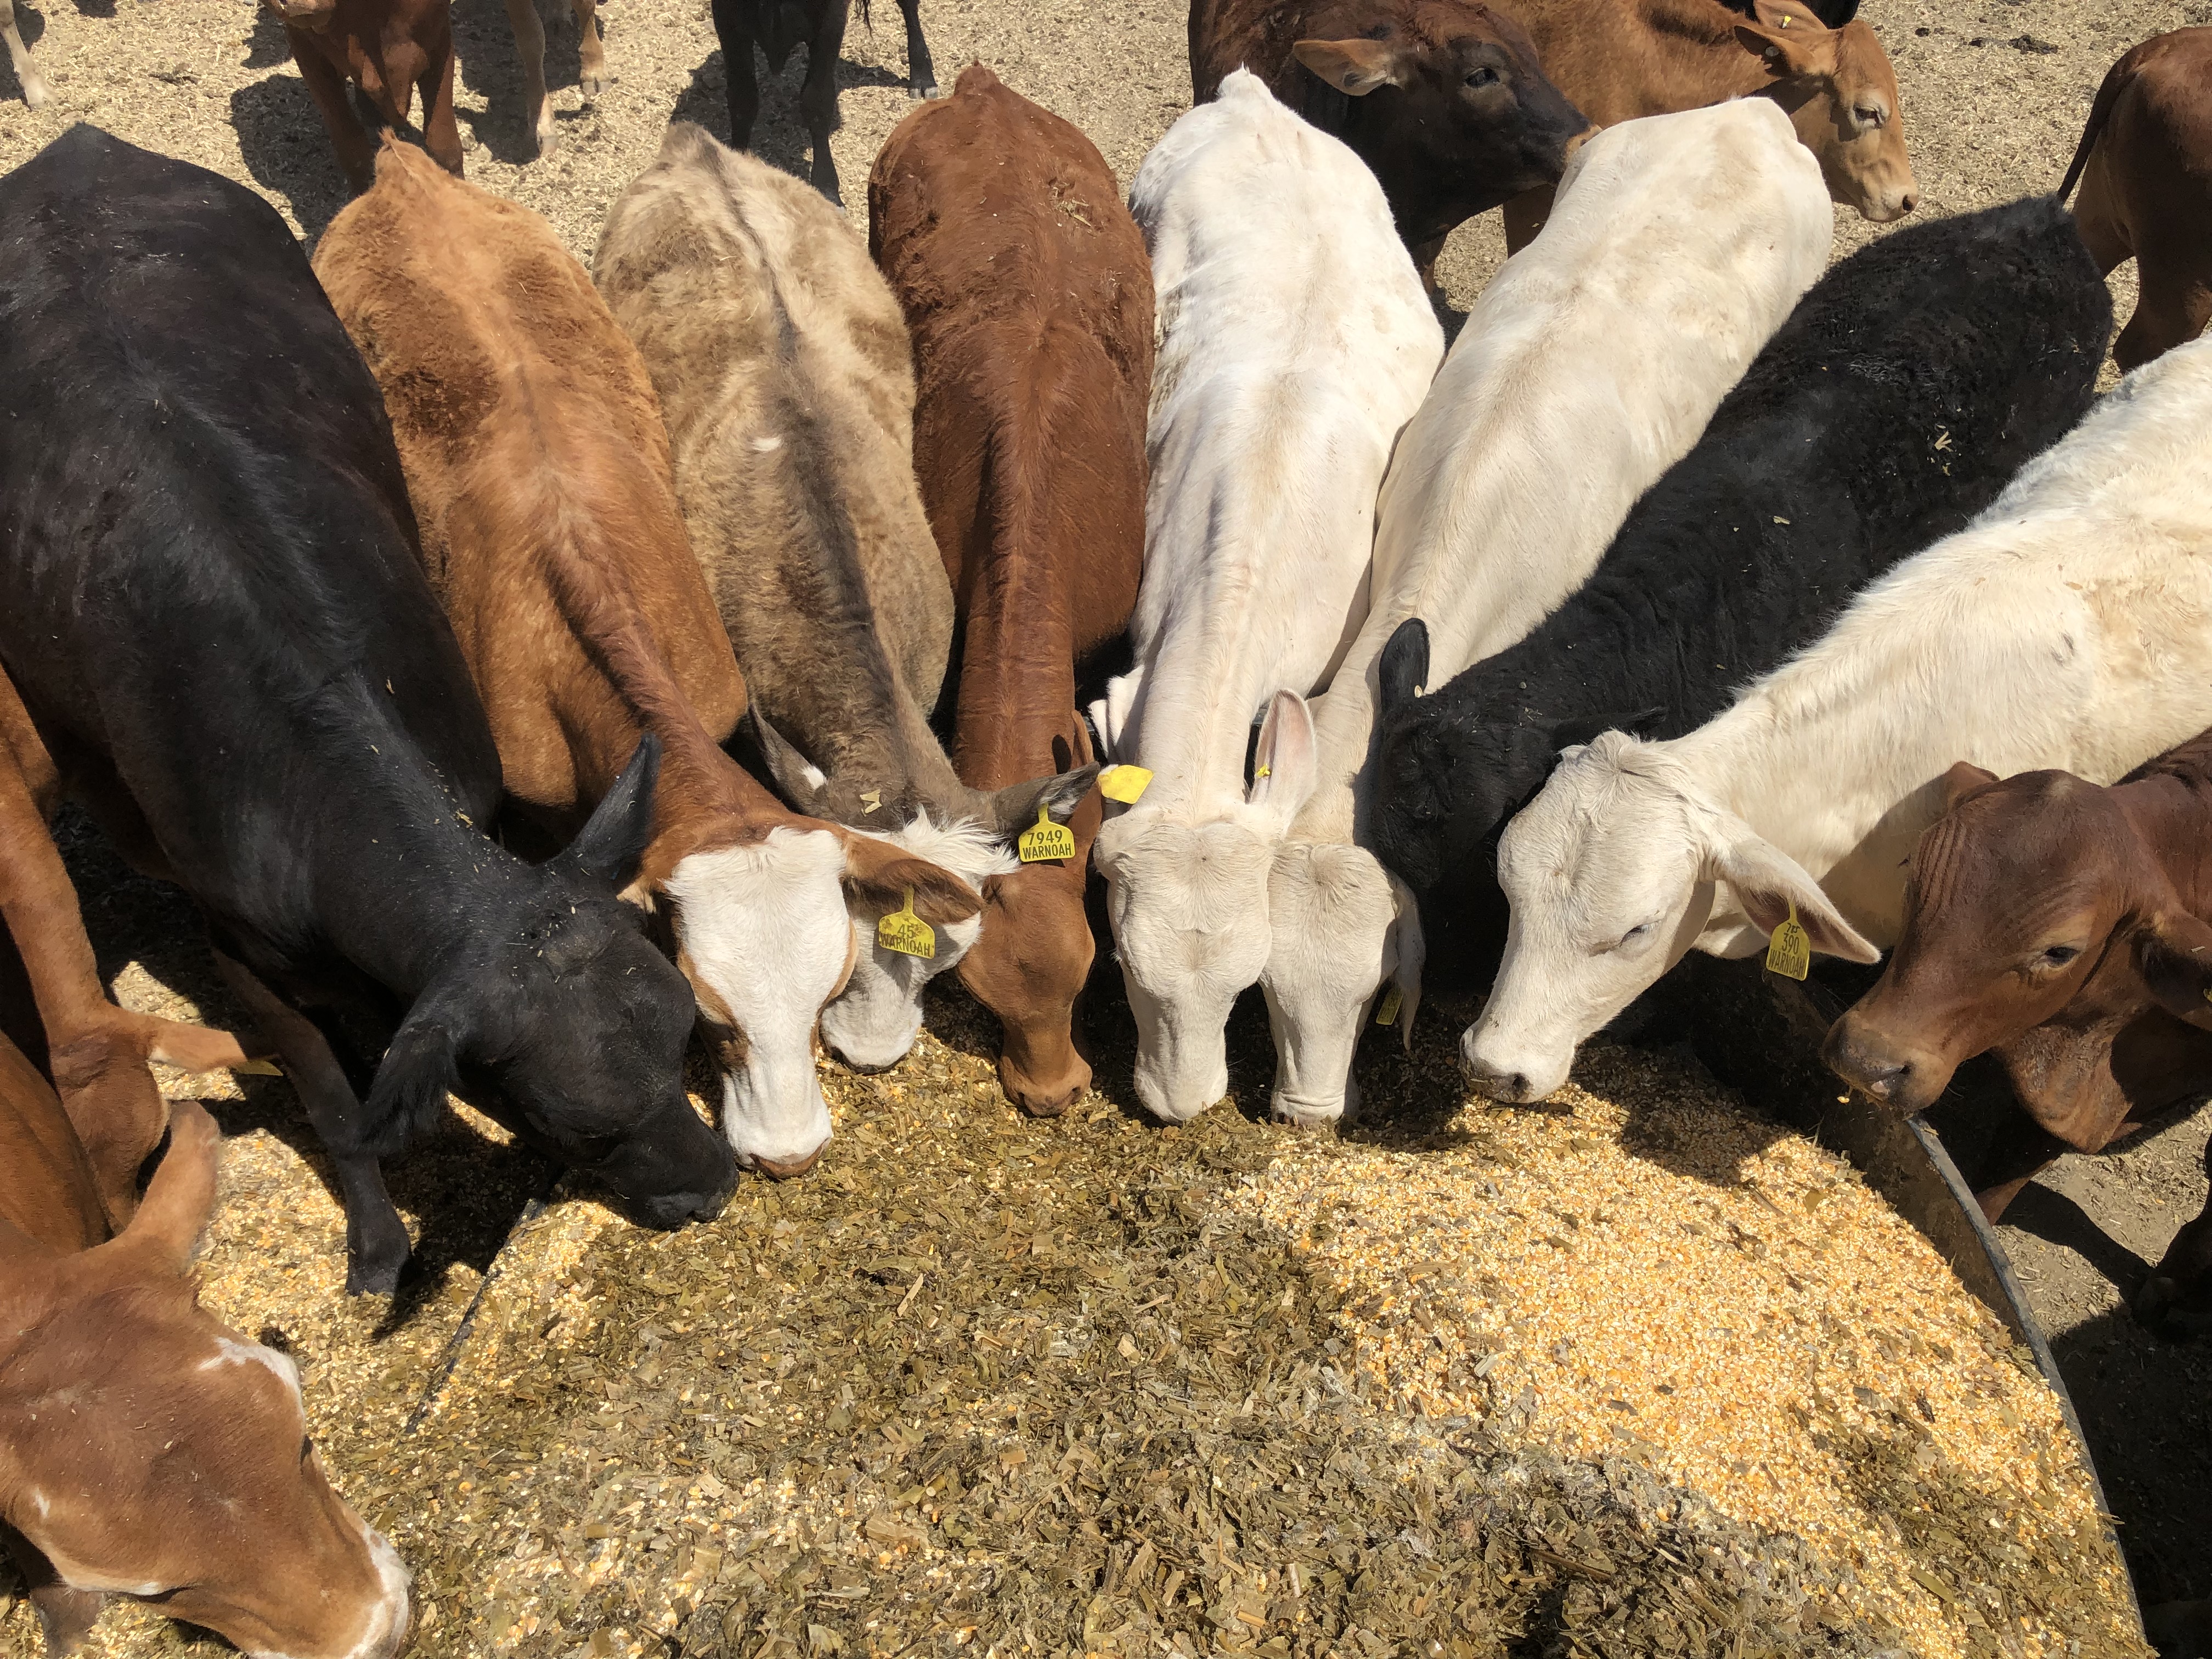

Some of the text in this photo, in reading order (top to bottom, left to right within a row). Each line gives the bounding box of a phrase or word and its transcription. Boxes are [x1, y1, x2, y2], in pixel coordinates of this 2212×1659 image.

[1028, 830, 1063, 845] 7949
[1023, 843, 1071, 860] WARNOAH
[897, 924, 915, 939] 45
[880, 932, 930, 957] WARNOAH
[1782, 933, 1799, 955] 390
[1768, 949, 1805, 978] WARNOAH
